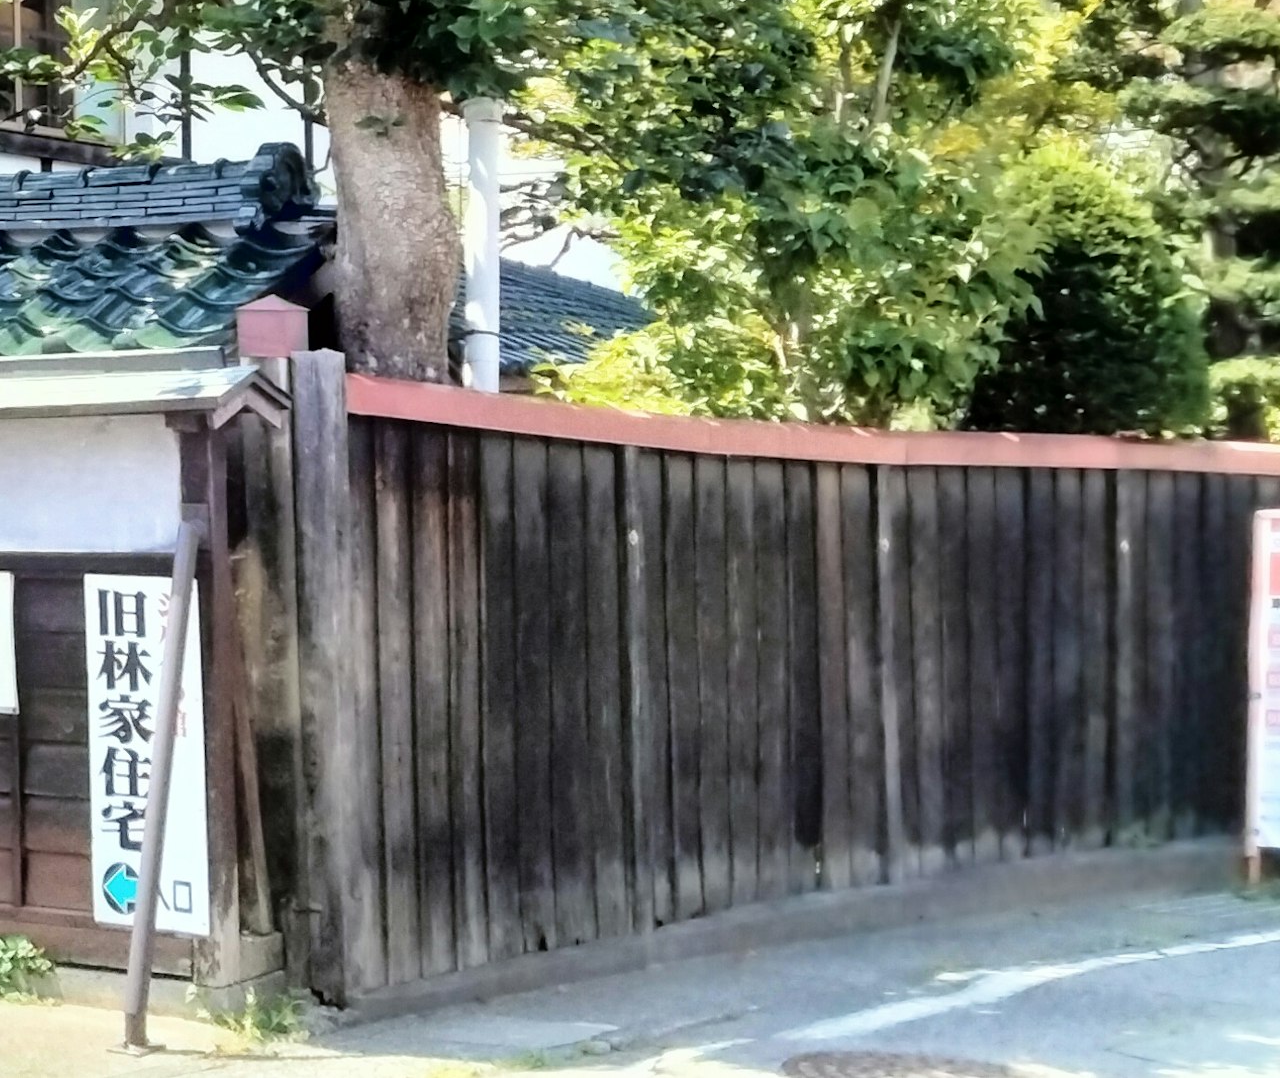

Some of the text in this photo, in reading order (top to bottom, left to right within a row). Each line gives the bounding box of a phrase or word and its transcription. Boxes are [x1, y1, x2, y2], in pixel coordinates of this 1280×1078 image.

[96, 588, 155, 852] 旧林家住宅
